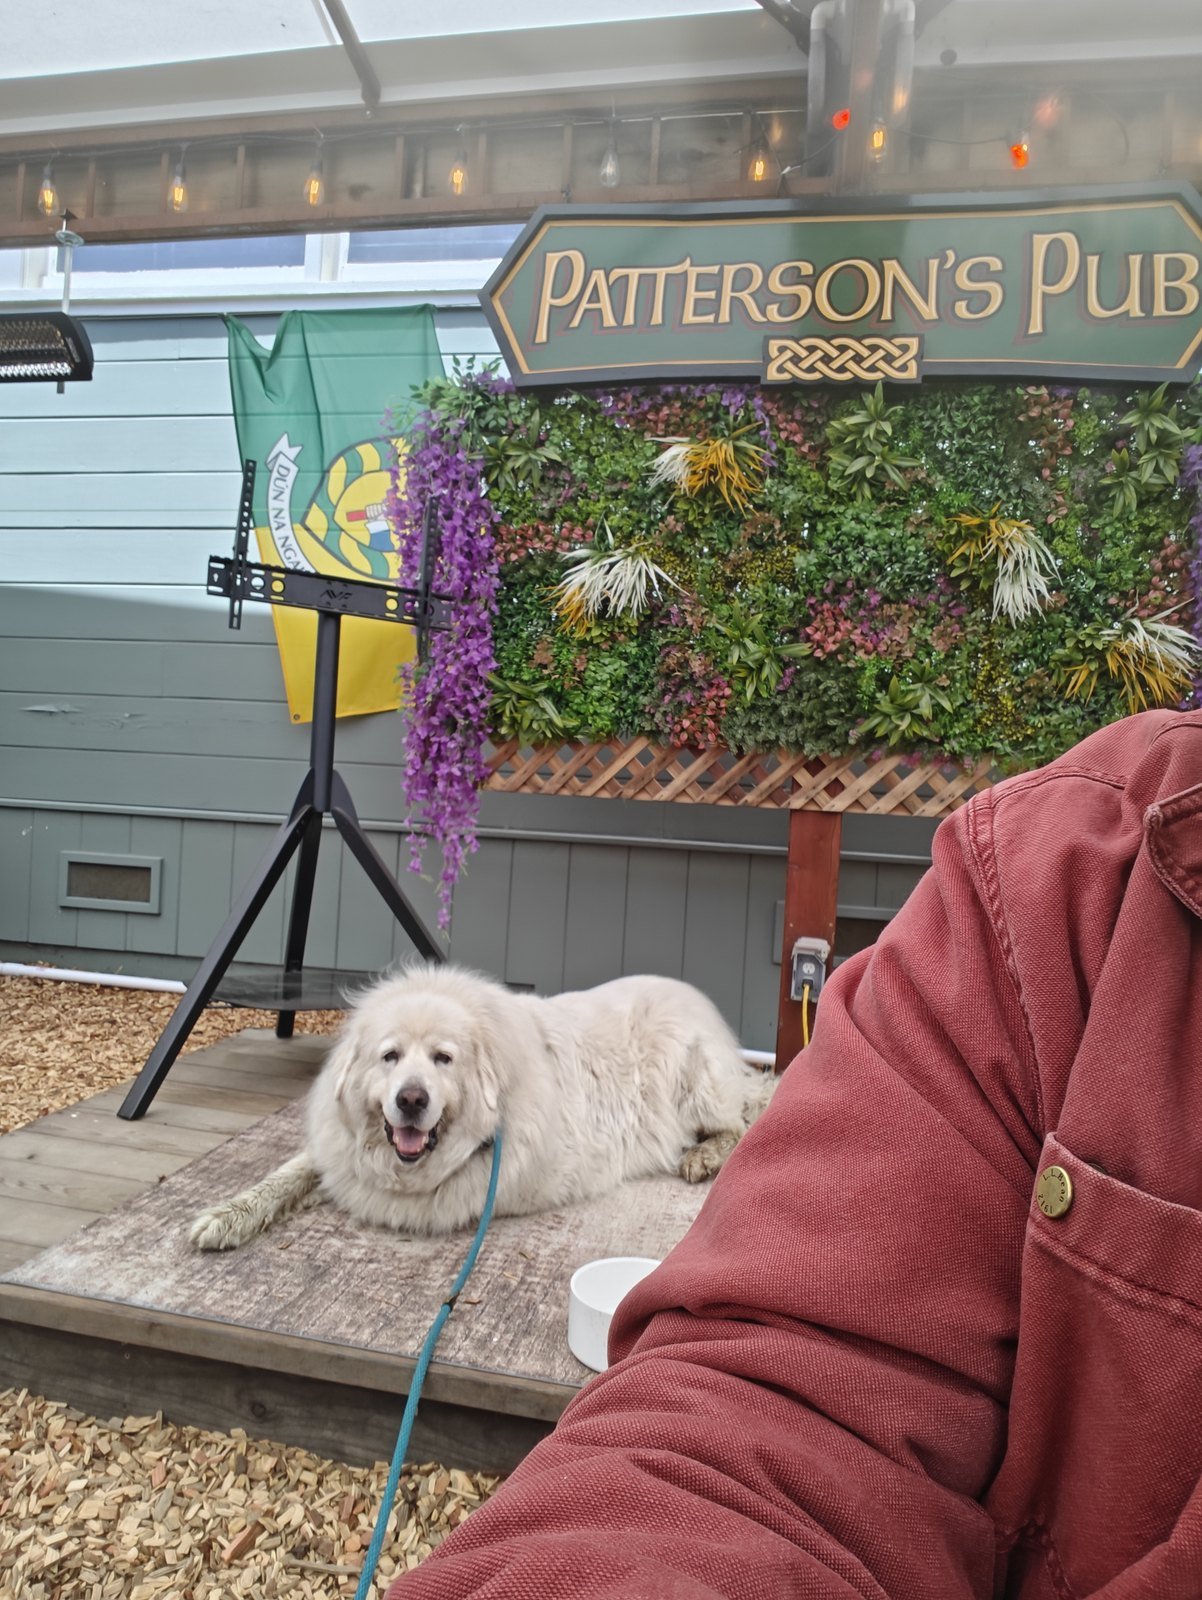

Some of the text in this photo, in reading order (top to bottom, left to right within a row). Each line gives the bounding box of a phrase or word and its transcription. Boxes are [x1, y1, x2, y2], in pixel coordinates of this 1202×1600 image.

[534, 231, 1201, 344] PATTERSON'S PUB
[271, 463, 305, 570] DÚN NA NGA
[1037, 1193, 1053, 1214] 1912
